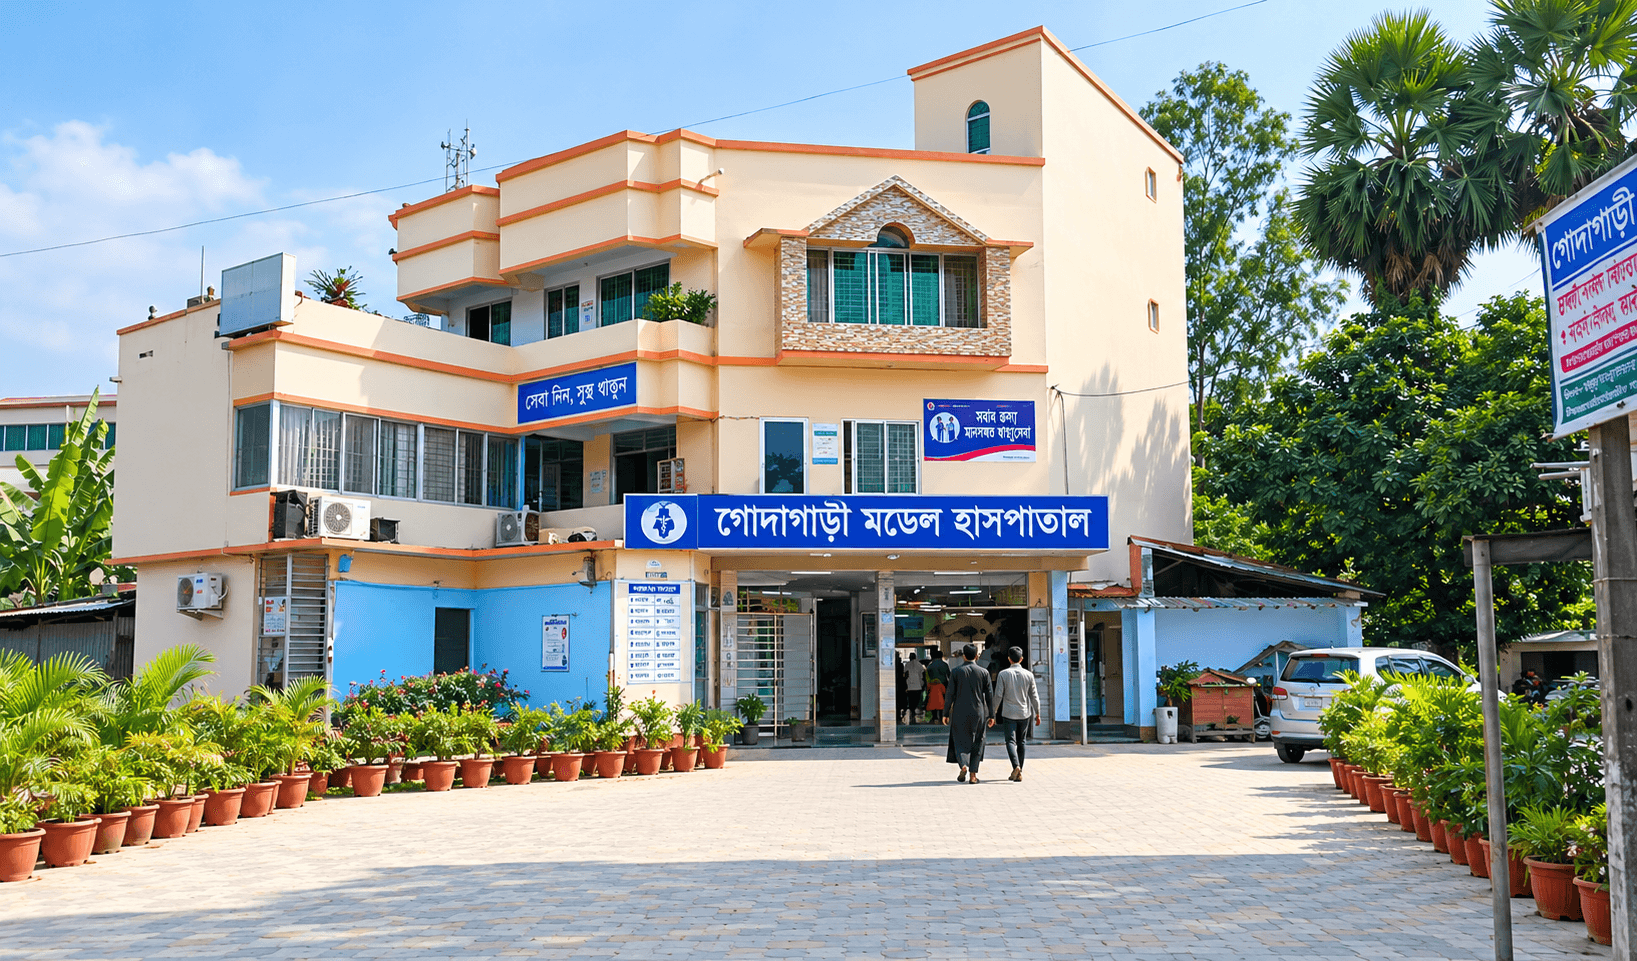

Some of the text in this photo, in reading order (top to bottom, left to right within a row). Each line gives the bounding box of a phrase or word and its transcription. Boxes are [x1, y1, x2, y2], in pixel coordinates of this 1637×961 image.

[1552, 186, 1635, 269] গোদাগাড়ী
[525, 389, 549, 410] সেবা
[551, 384, 573, 405] নিন,
[714, 500, 1092, 542] গোদাগাড়ী মডেল হাসপাতাল
